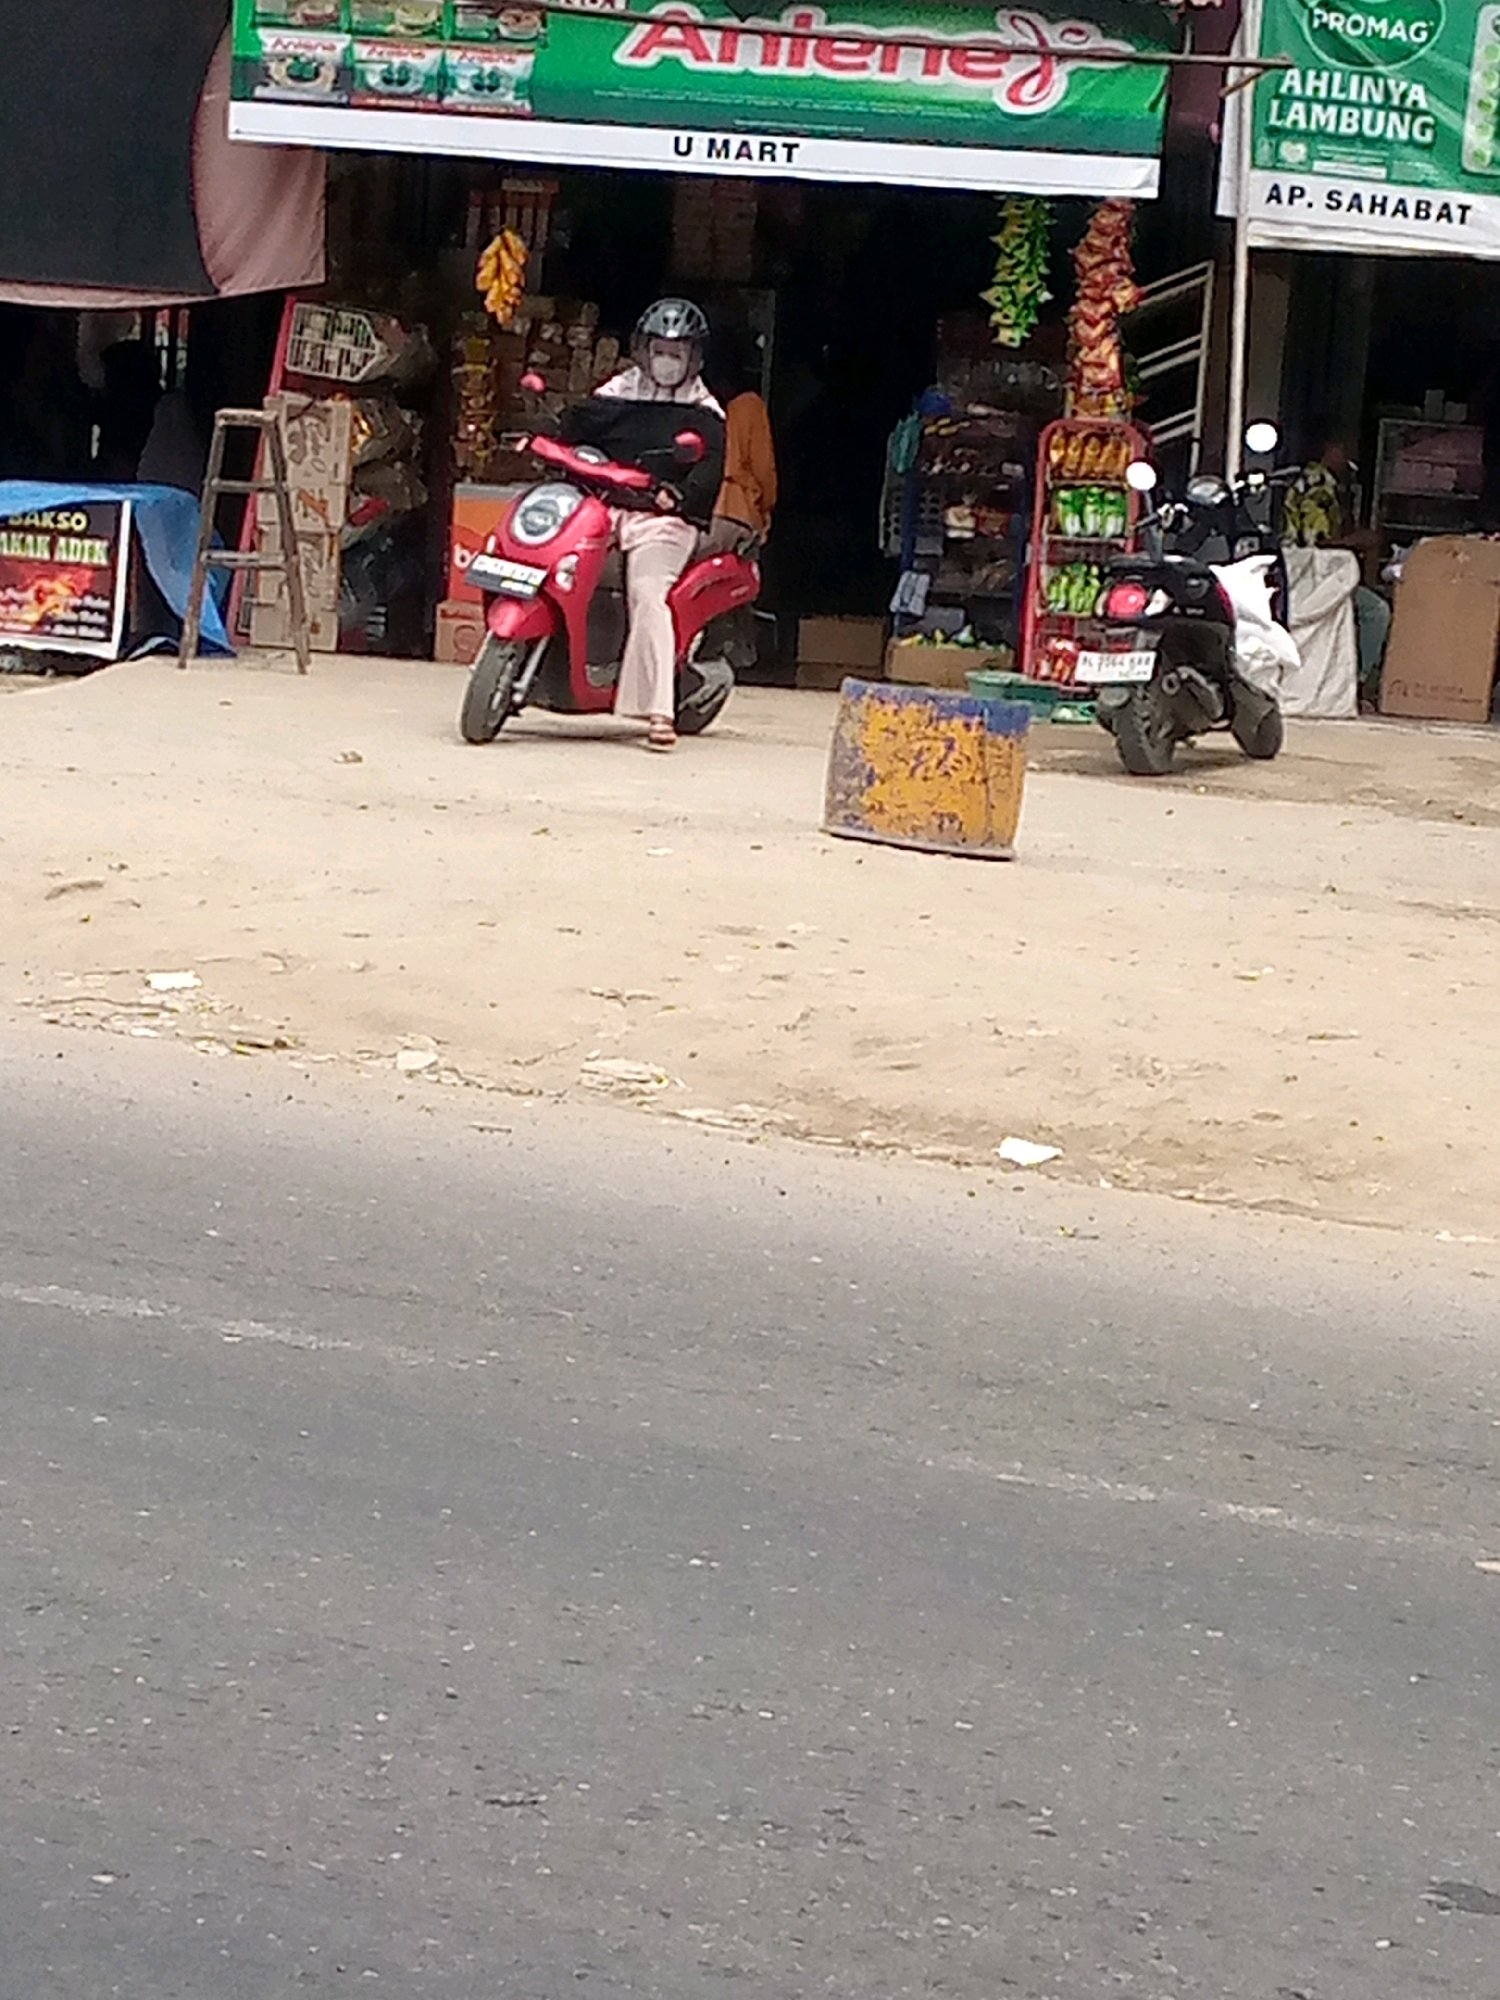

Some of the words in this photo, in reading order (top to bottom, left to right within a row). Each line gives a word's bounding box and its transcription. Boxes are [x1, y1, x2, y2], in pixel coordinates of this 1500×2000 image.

[628, 9, 1011, 79] Anlene
[1312, 8, 1429, 43] PROMAG
[1279, 67, 1429, 109] AHLINYA
[1268, 98, 1436, 143] LAMBUNG
[673, 136, 693, 157] U
[706, 137, 800, 163] MART
[1265, 183, 1313, 209] AP.
[1325, 189, 1472, 225] SAHABAT
